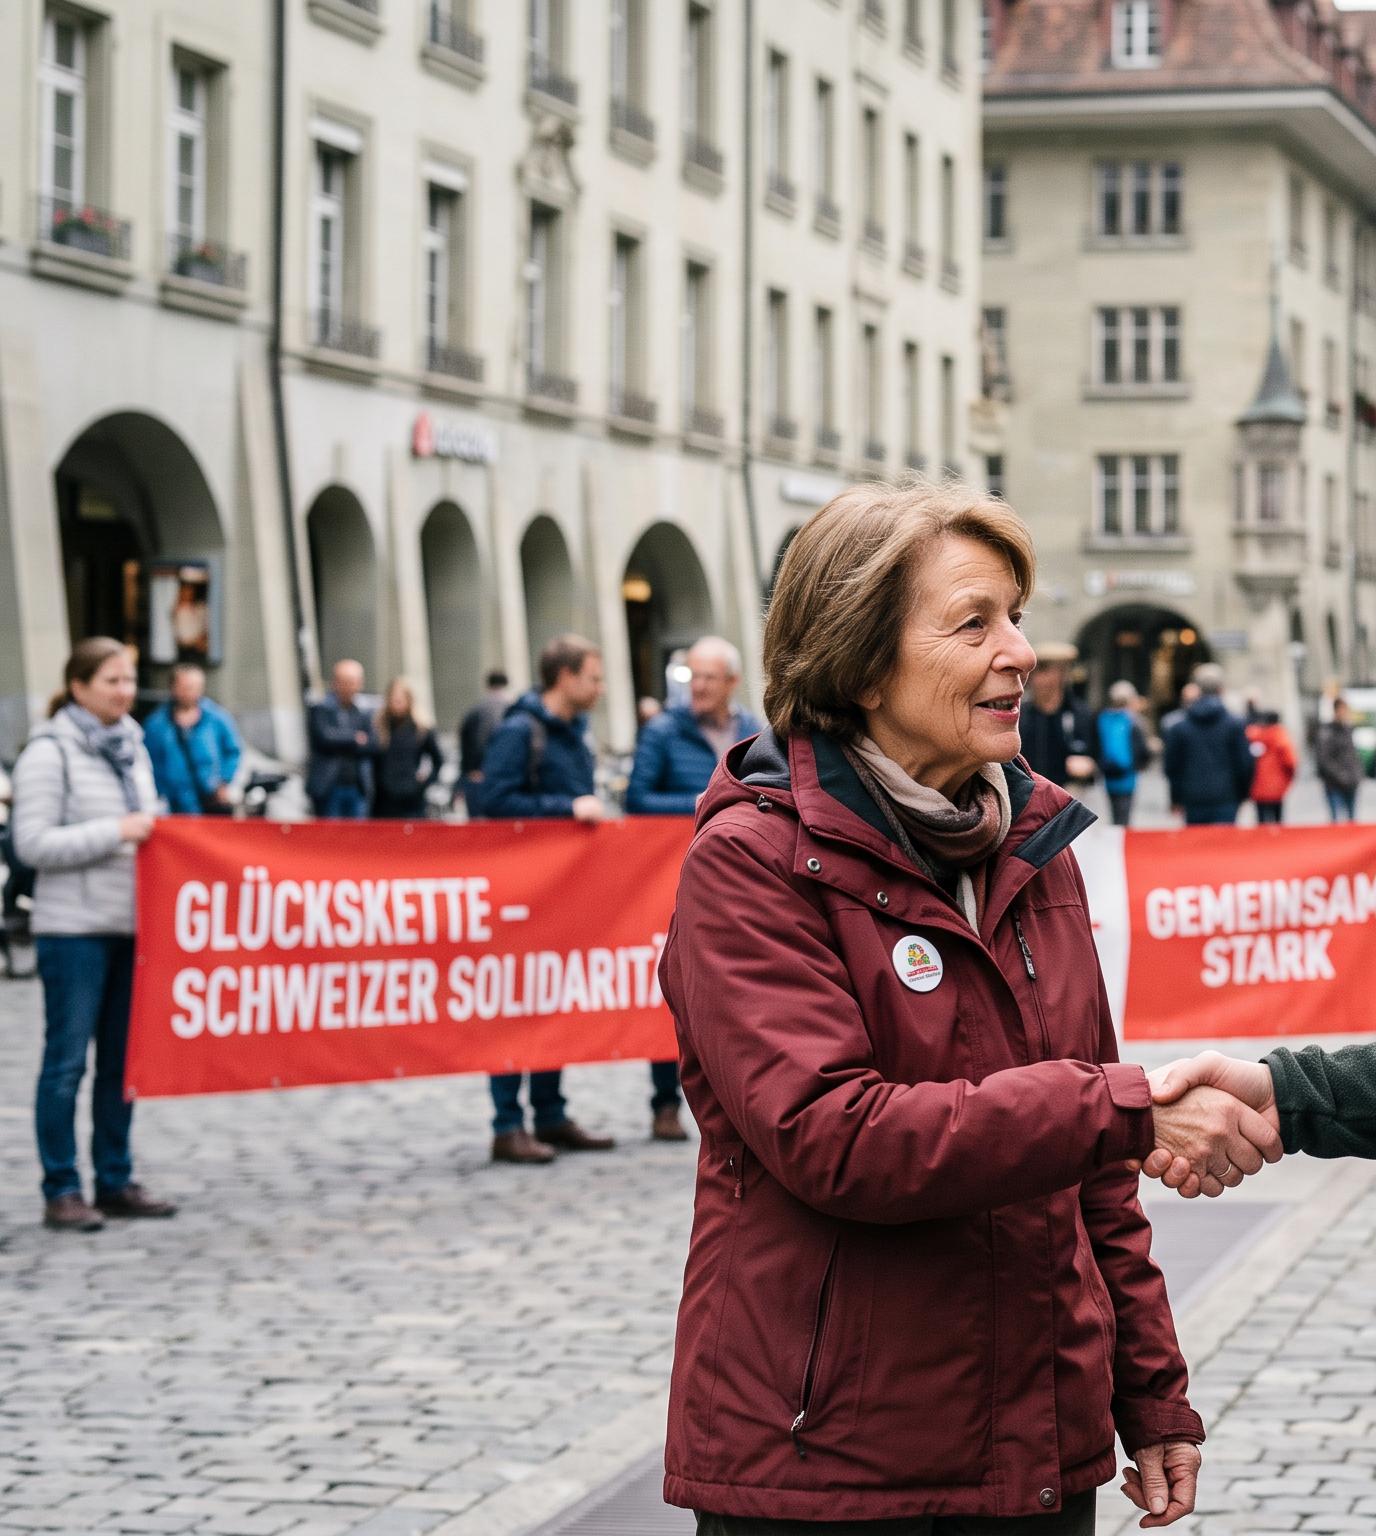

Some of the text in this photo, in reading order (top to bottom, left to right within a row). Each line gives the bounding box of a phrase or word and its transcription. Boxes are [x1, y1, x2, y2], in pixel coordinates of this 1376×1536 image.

[175, 866, 492, 952] GLÜCKSKETTE
[171, 958, 438, 1038] SCHWEIZER
[1201, 930, 1336, 988] STARK
